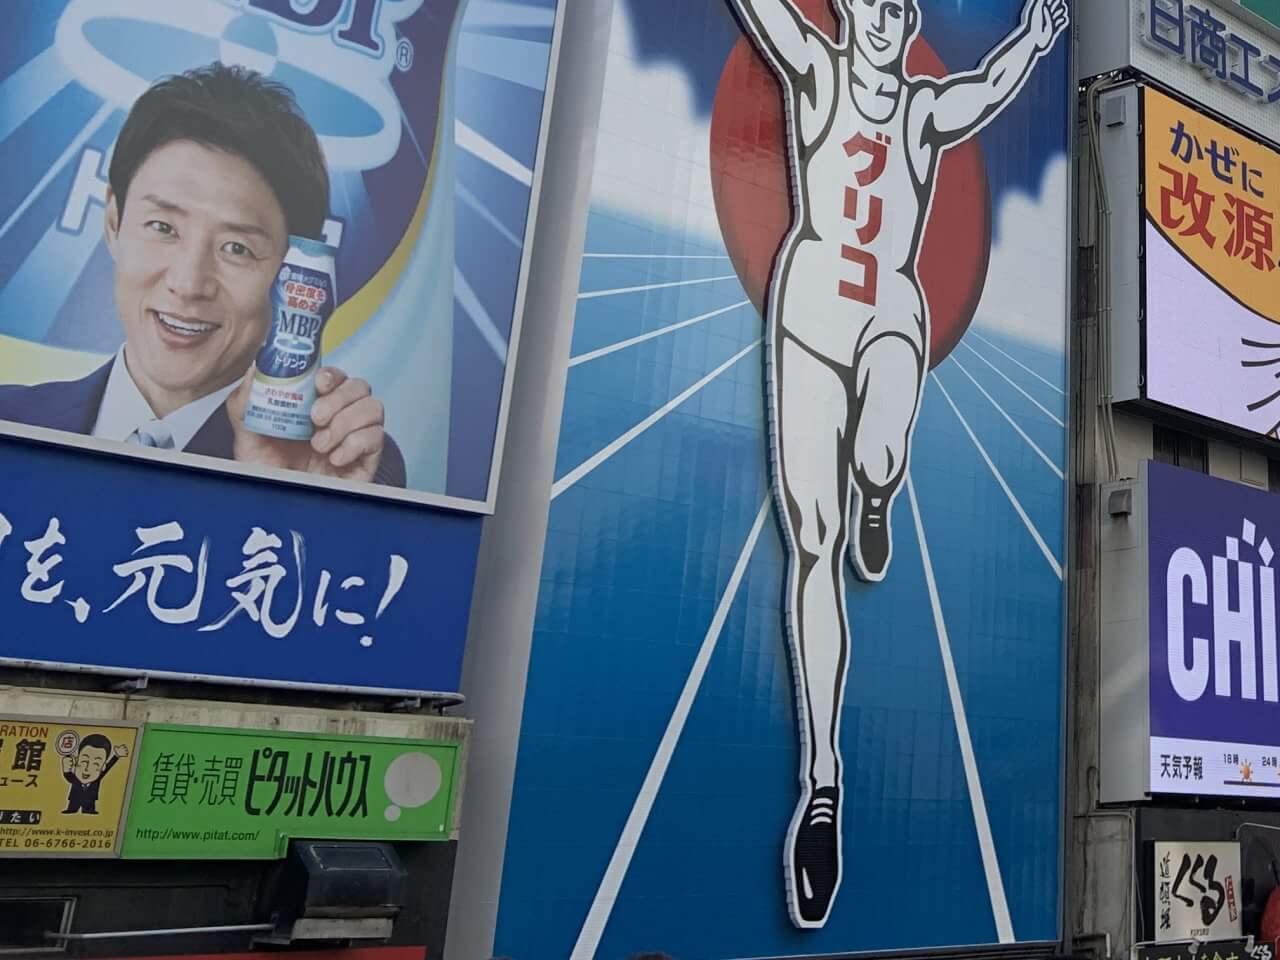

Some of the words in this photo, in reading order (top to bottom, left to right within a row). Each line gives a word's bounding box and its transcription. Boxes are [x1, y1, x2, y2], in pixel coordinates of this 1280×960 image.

[1169, 120, 1265, 199] かぜに
[838, 131, 892, 307] グリコ
[1158, 162, 1276, 273] 改源
[278, 311, 321, 338] MBP
[147, 752, 244, 807] 賃貸・売買
[244, 746, 371, 820] ピタットハウス
[1160, 753, 1204, 781] 天気予報
[24, 839, 112, 849] 06-6766-2016
[136, 827, 260, 842] http://www.pitat.com/
[1171, 853, 1226, 927] くくる
